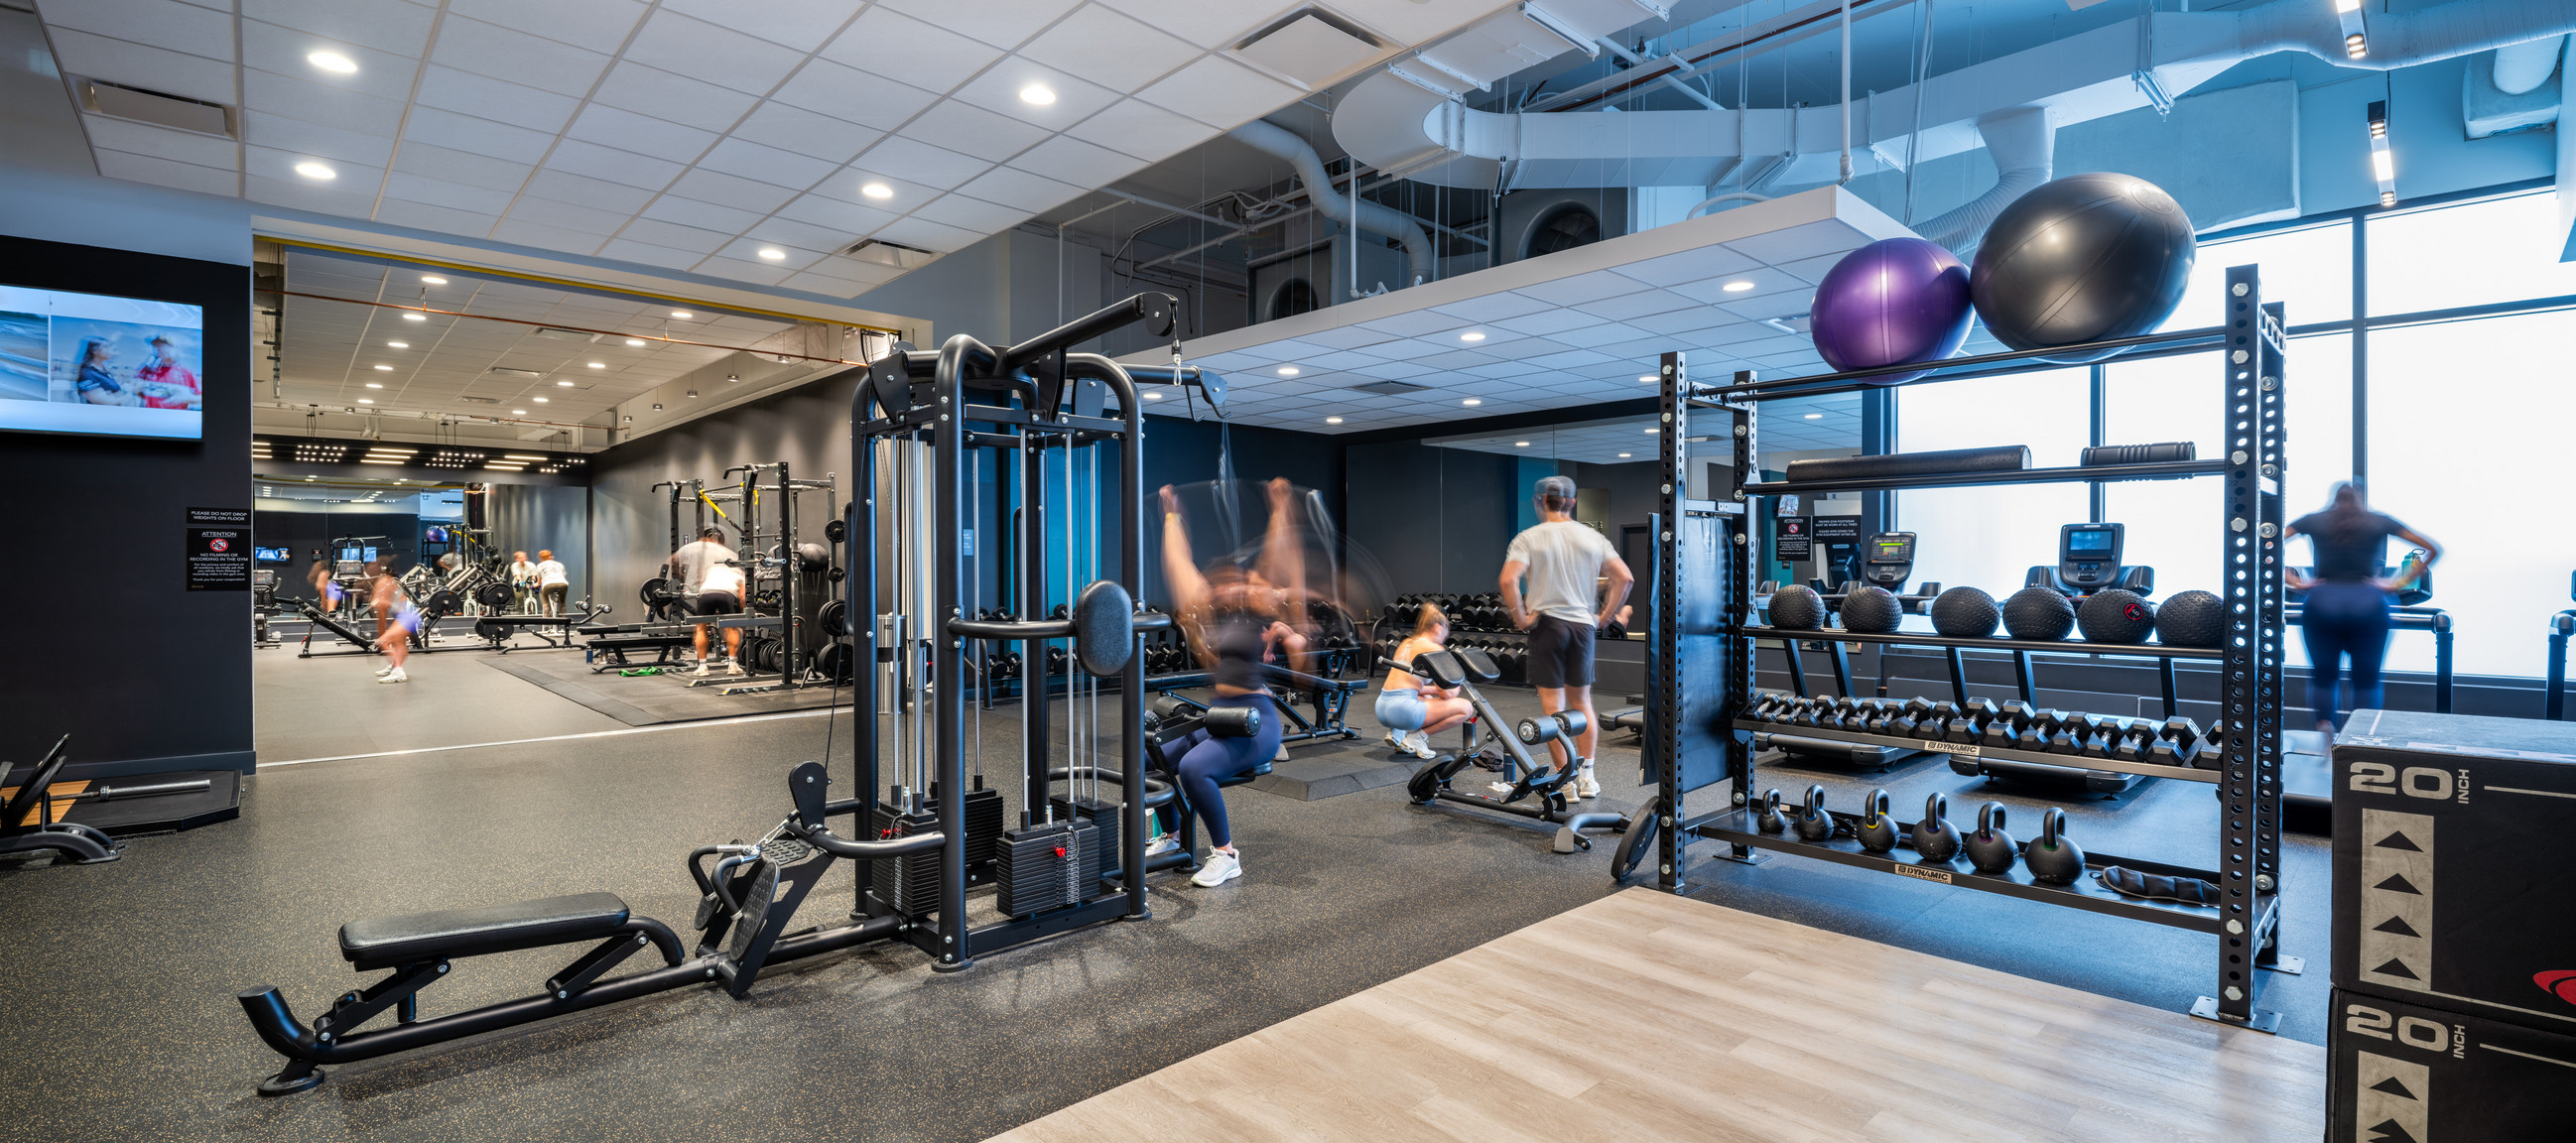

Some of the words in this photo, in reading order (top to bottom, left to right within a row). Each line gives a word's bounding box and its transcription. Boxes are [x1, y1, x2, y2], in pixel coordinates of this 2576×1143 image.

[1937, 742, 1978, 753] DYNAMIC
[2349, 761, 2453, 801] 20
[2458, 768, 2470, 805] INCH
[1907, 866, 1949, 880] DYNAMIC
[2346, 1003, 2449, 1053] 20
[2453, 1023, 2465, 1060] INCH
